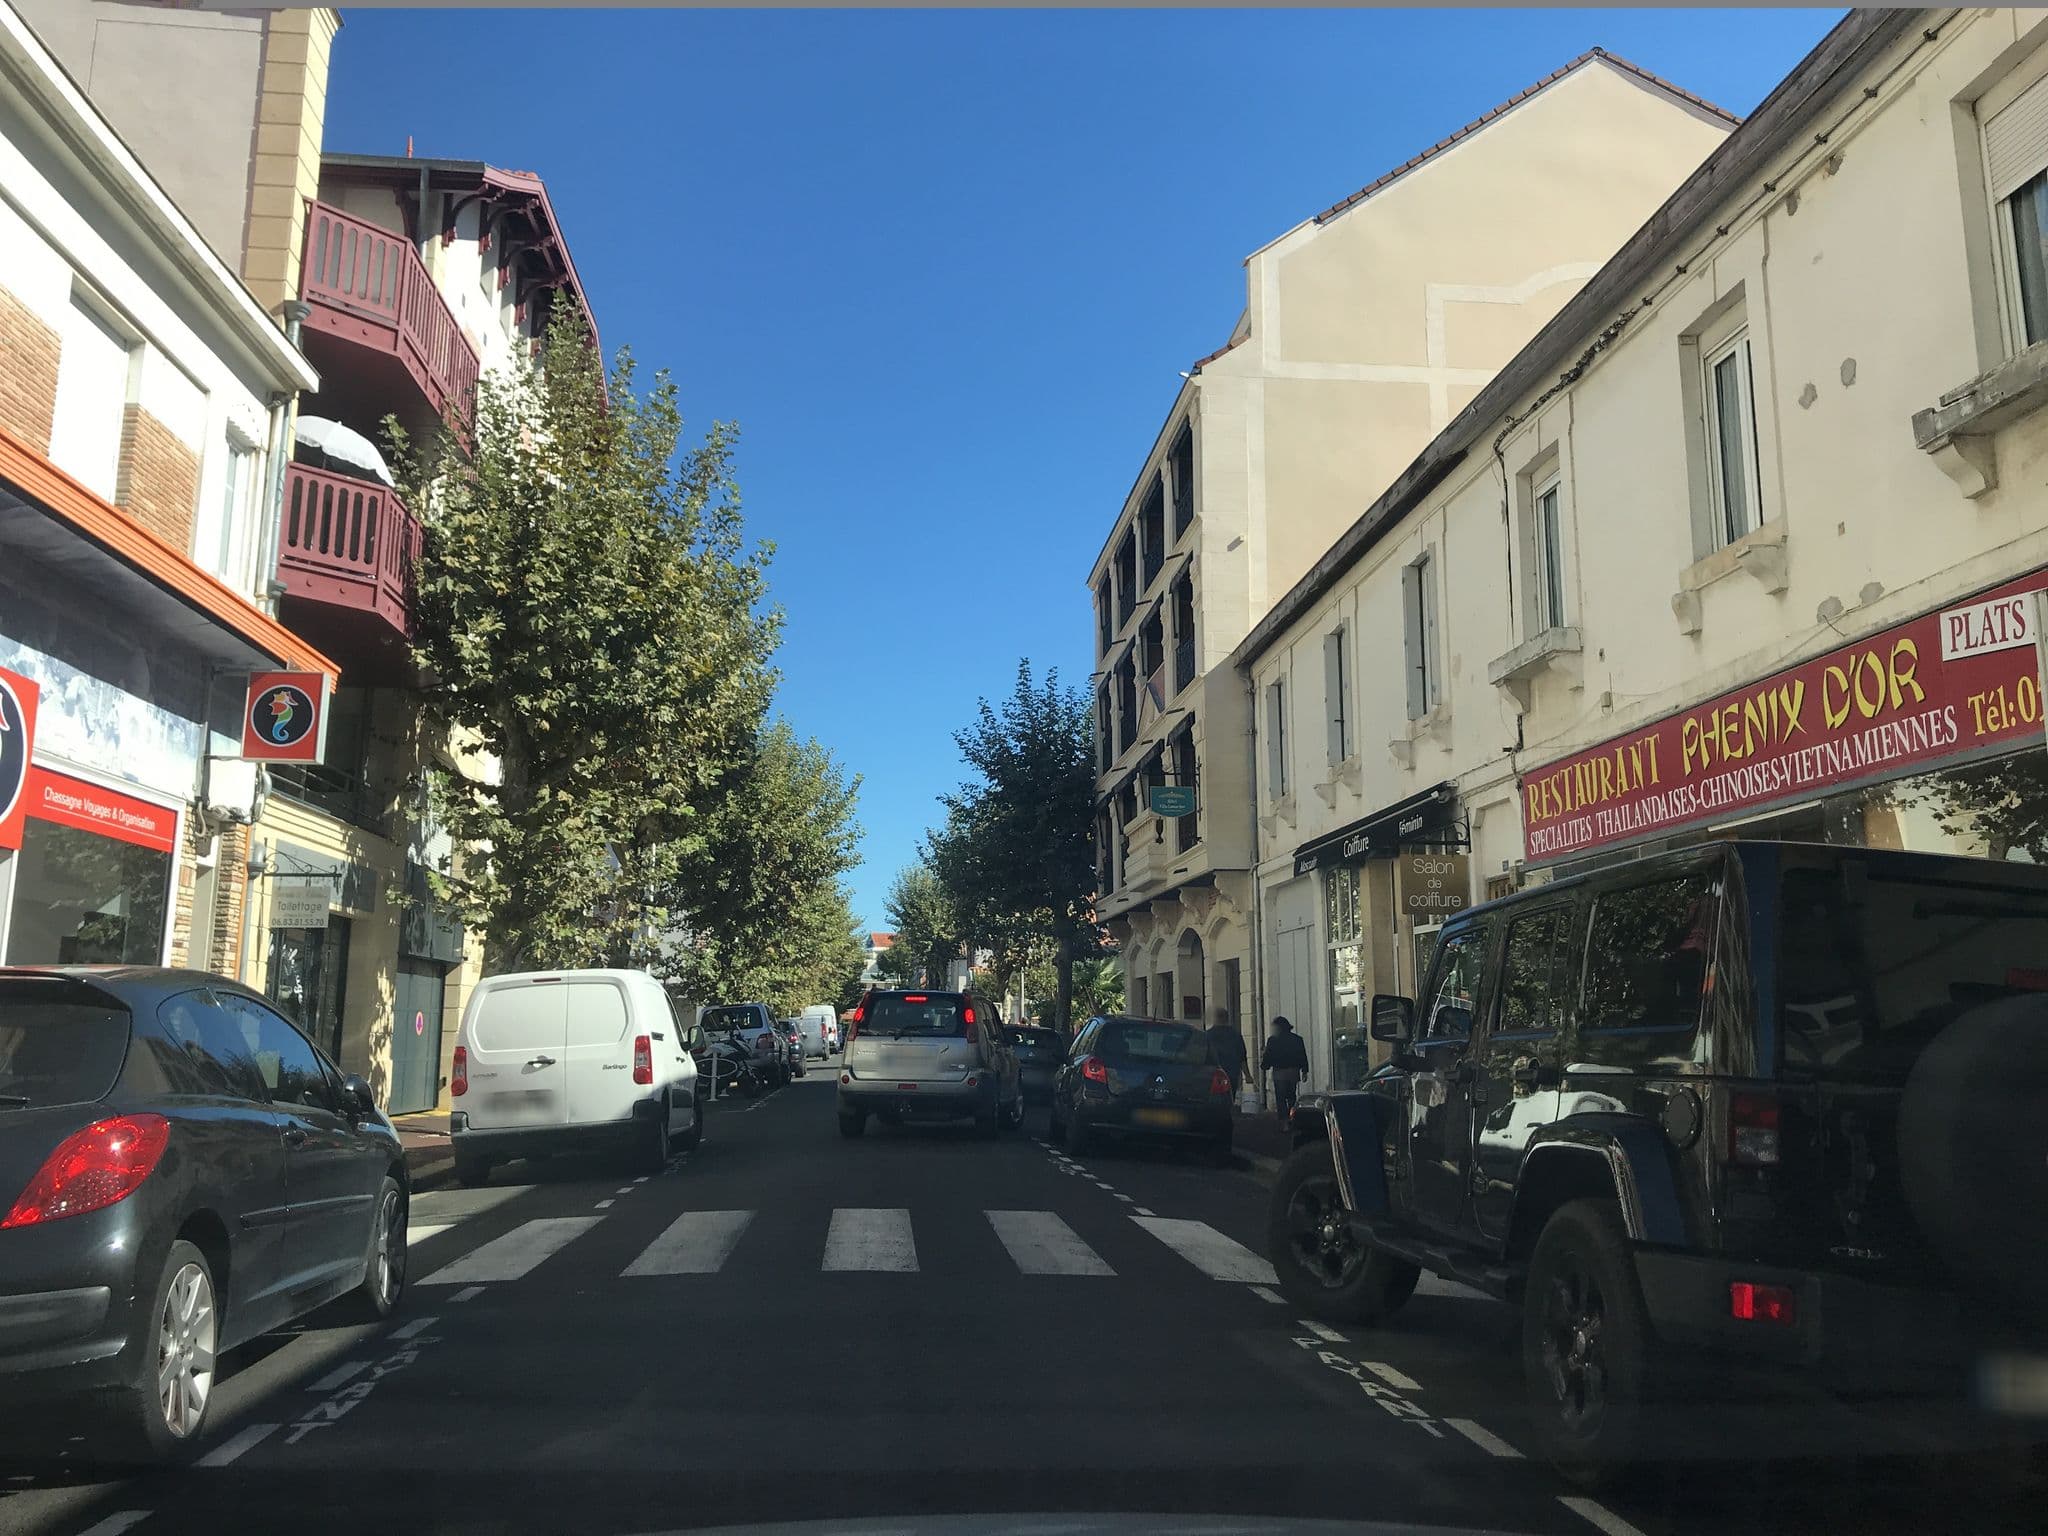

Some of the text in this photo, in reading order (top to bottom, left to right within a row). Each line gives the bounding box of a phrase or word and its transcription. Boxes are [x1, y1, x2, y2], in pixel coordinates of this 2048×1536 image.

[1950, 599, 2026, 653] PLATS
[1527, 638, 1926, 824] RESTAURANT PHENIX D'OR
[44, 786, 156, 831] Chassagne Voyages & Organisation
[1343, 834, 1370, 858] Coiffure
[1530, 815, 1593, 856] SPECIALITES
[1413, 858, 1455, 875] Salon
[1427, 878, 1442, 888] de
[278, 901, 323, 914] Toilettage
[1409, 892, 1462, 907] coiffure
